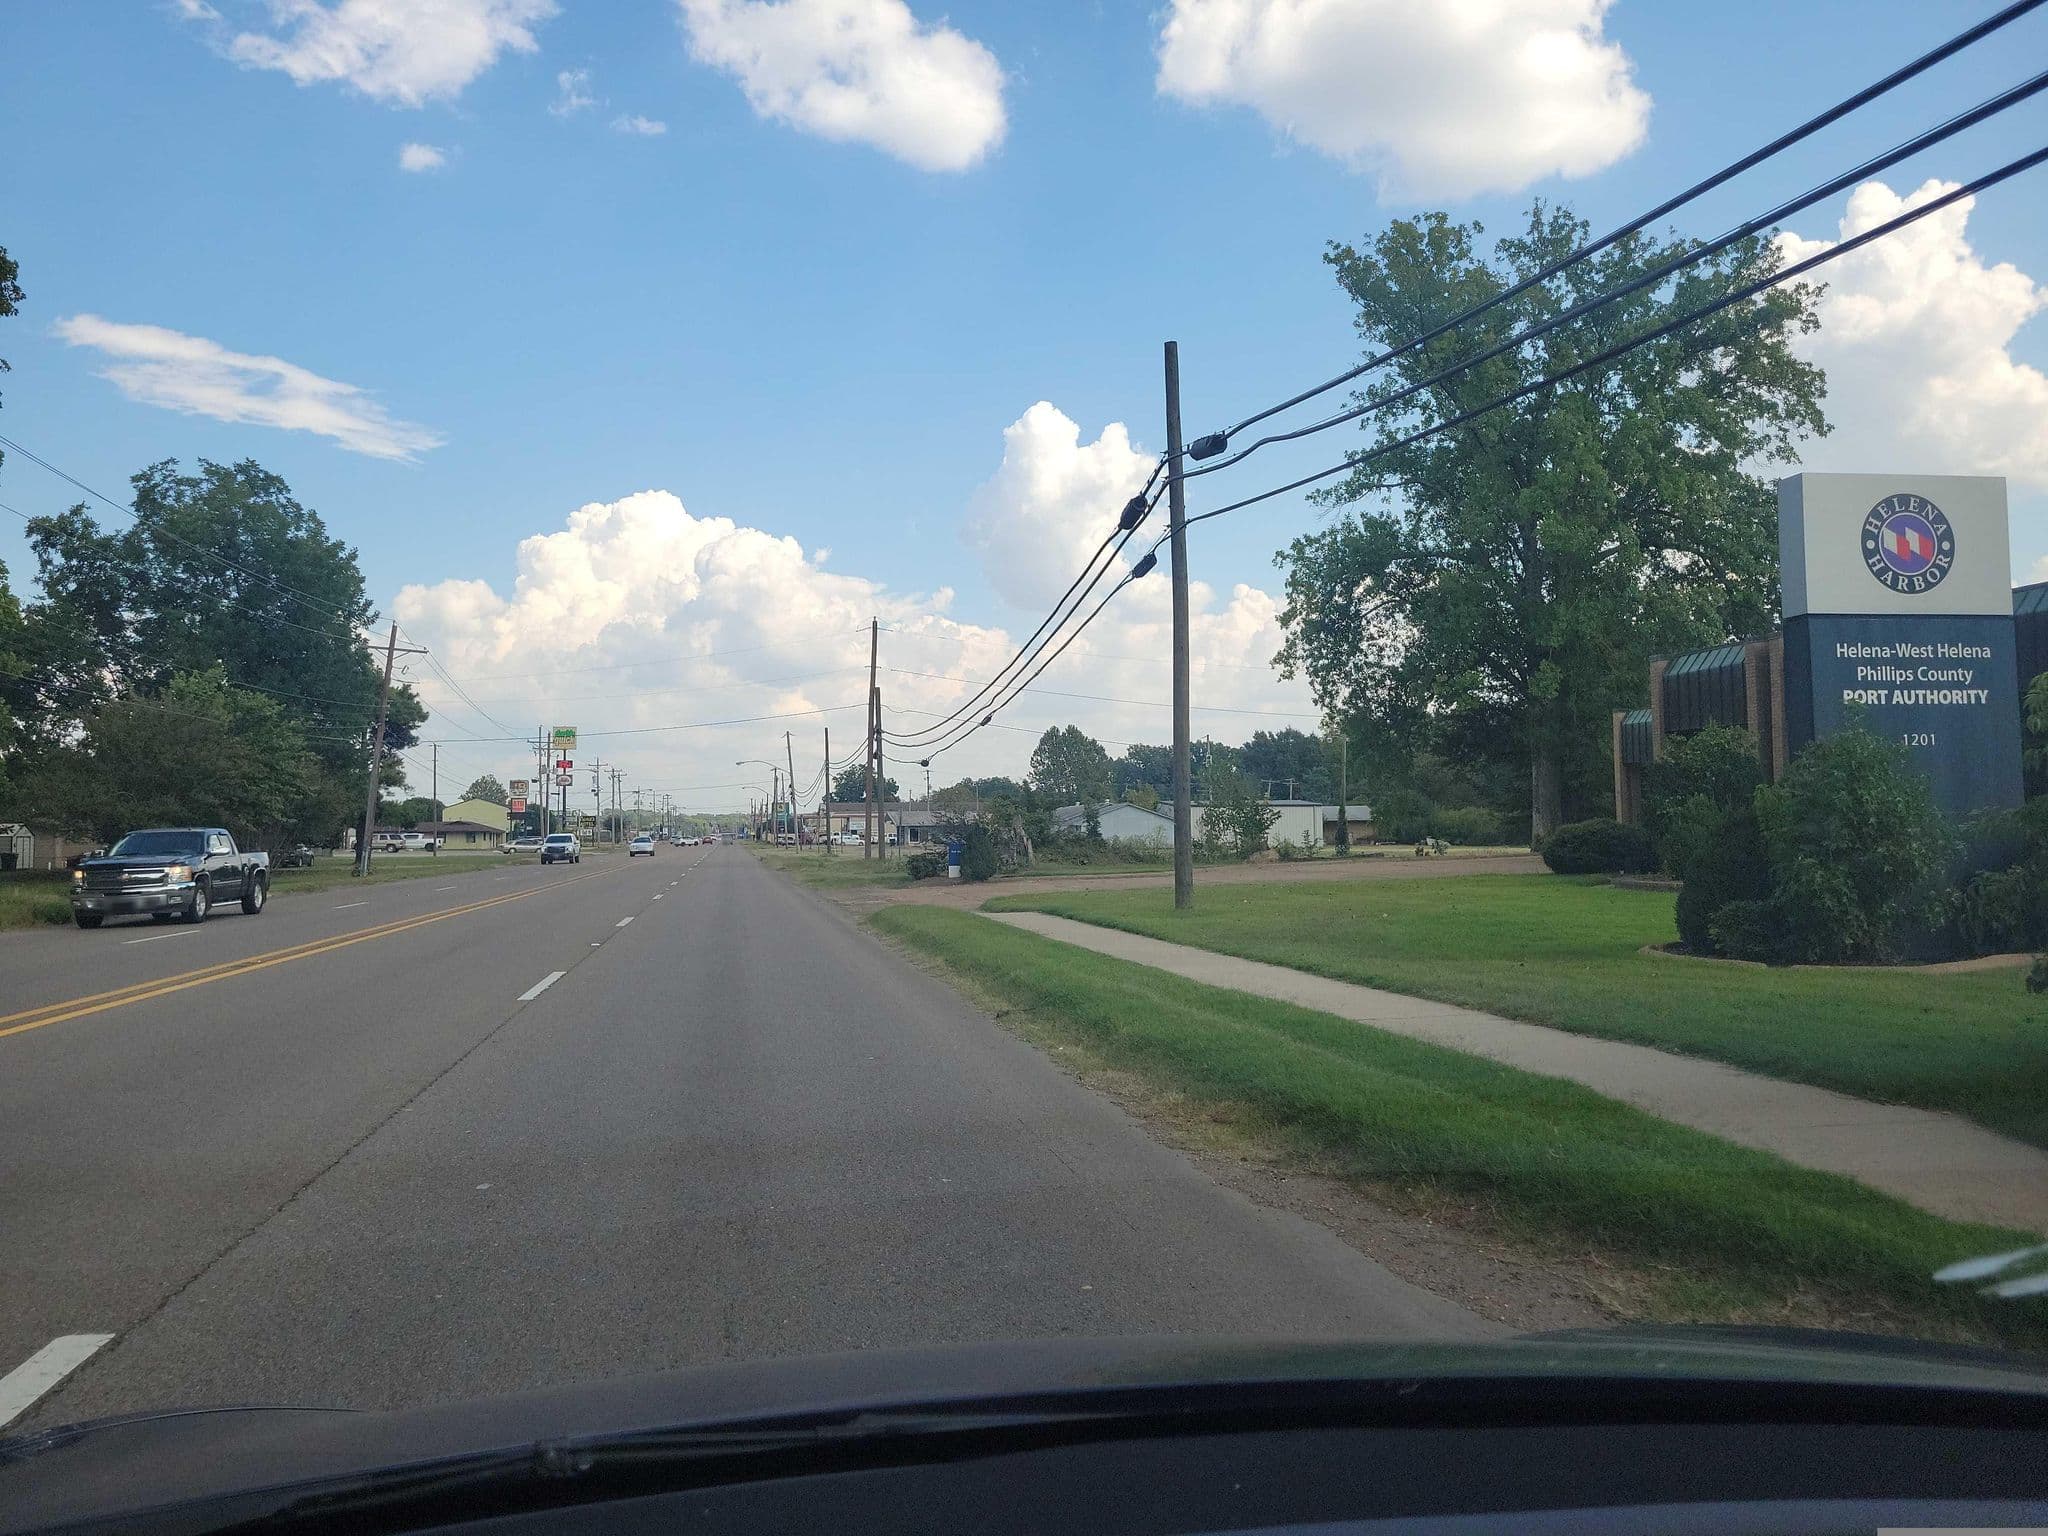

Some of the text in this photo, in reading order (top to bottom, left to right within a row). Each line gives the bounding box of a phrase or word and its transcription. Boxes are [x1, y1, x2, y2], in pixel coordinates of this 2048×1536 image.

[1865, 497, 1947, 537] HELENA
[1868, 553, 1951, 592] HARBOR
[1836, 642, 1991, 658] Helena-West Helena
[1857, 666, 1973, 685] Phillips County
[1843, 689, 1989, 705] PORT AUTHORITY
[1903, 733, 1936, 746] 1201
